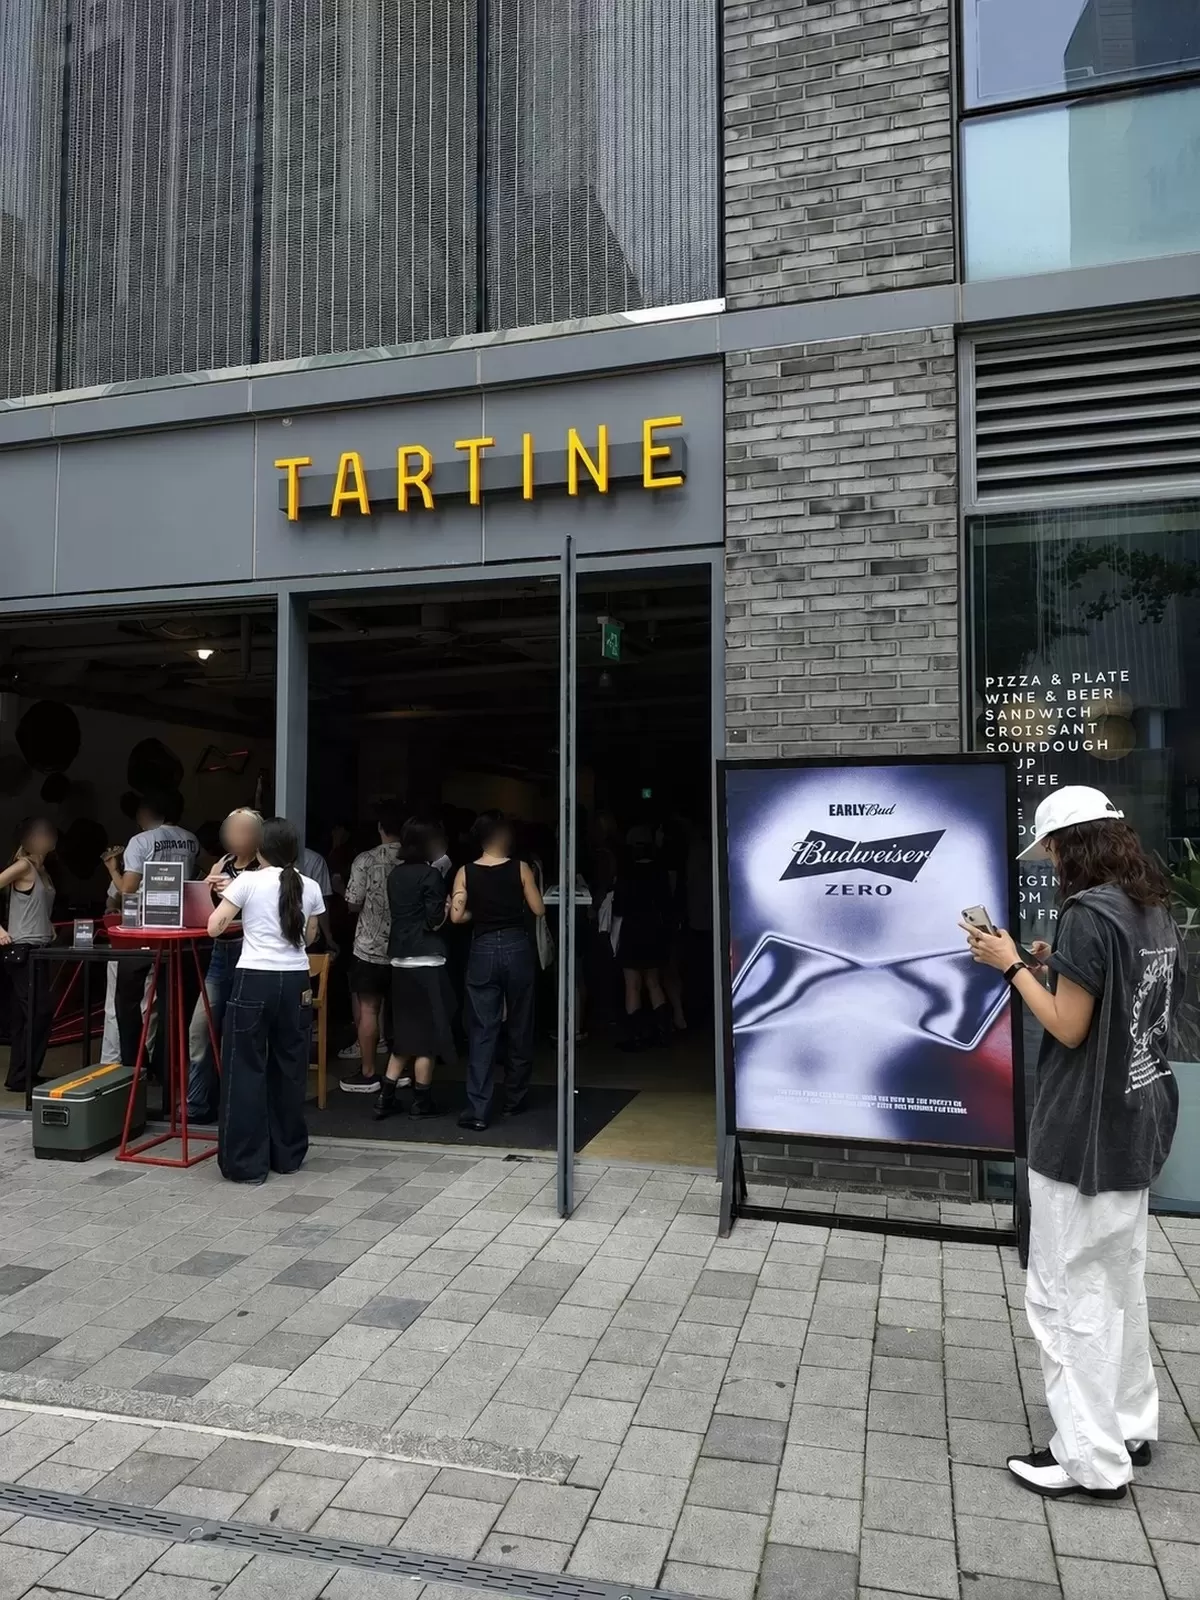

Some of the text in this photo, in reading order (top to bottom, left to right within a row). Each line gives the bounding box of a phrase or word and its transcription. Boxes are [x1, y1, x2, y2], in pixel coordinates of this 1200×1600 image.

[274, 415, 684, 521] TARTINE
[985, 670, 1130, 688] PIZZA & PLATE
[985, 688, 1113, 704] WINE & BEER
[985, 706, 1091, 721] SANDWICH
[985, 722, 1098, 738] CROISSANT
[986, 739, 1108, 753] SOURDOUGH
[791, 840, 931, 865] Budweiser
[825, 884, 892, 896] ZERO
